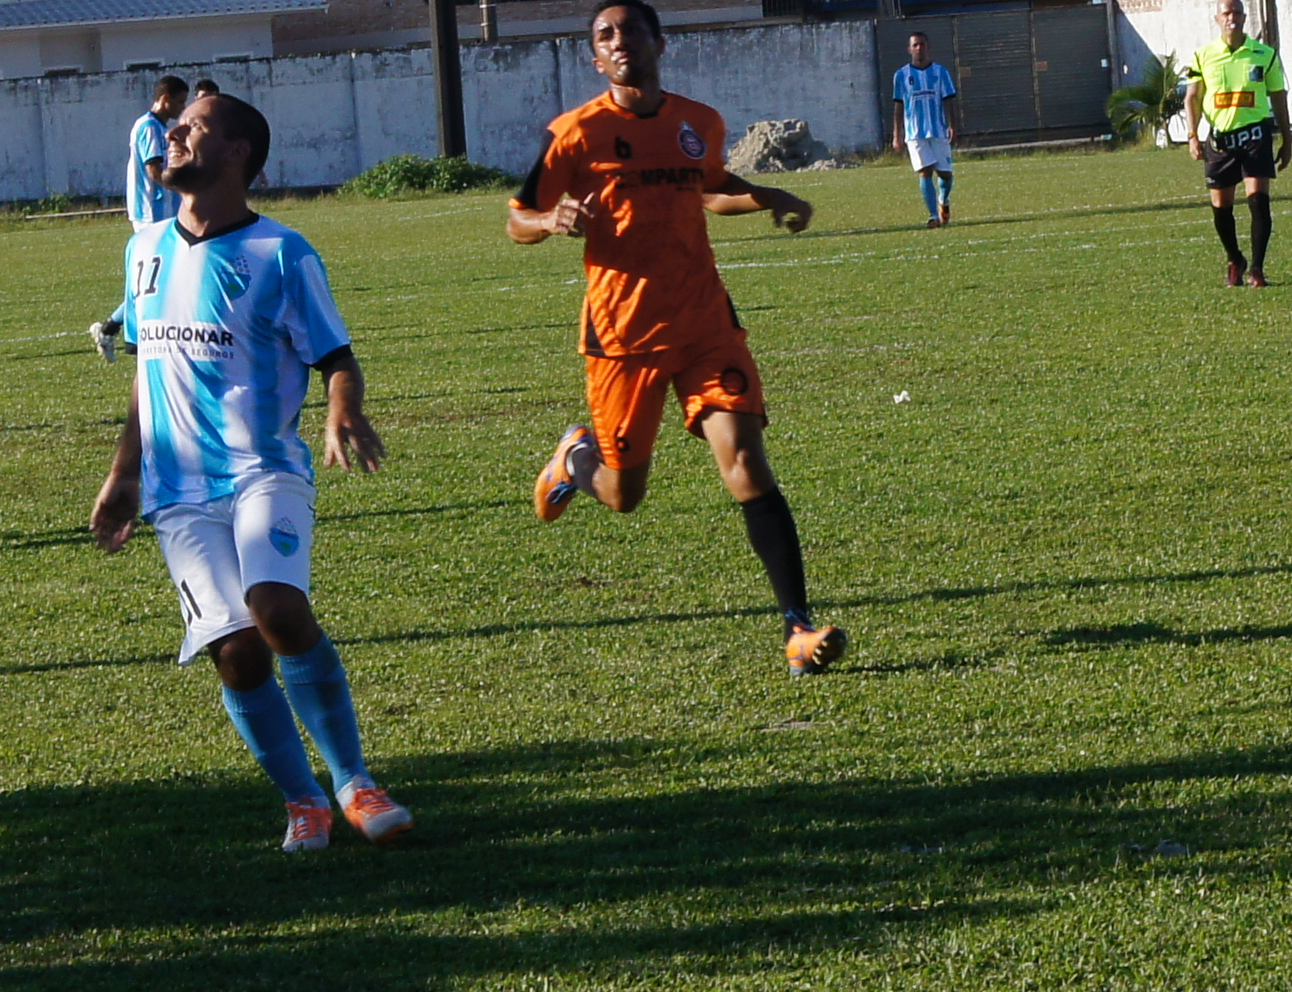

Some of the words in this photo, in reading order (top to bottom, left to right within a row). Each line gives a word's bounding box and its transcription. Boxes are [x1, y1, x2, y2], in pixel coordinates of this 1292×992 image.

[615, 136, 632, 159] 6
[135, 256, 162, 298] 11
[139, 325, 234, 347] OLUCIONAR
